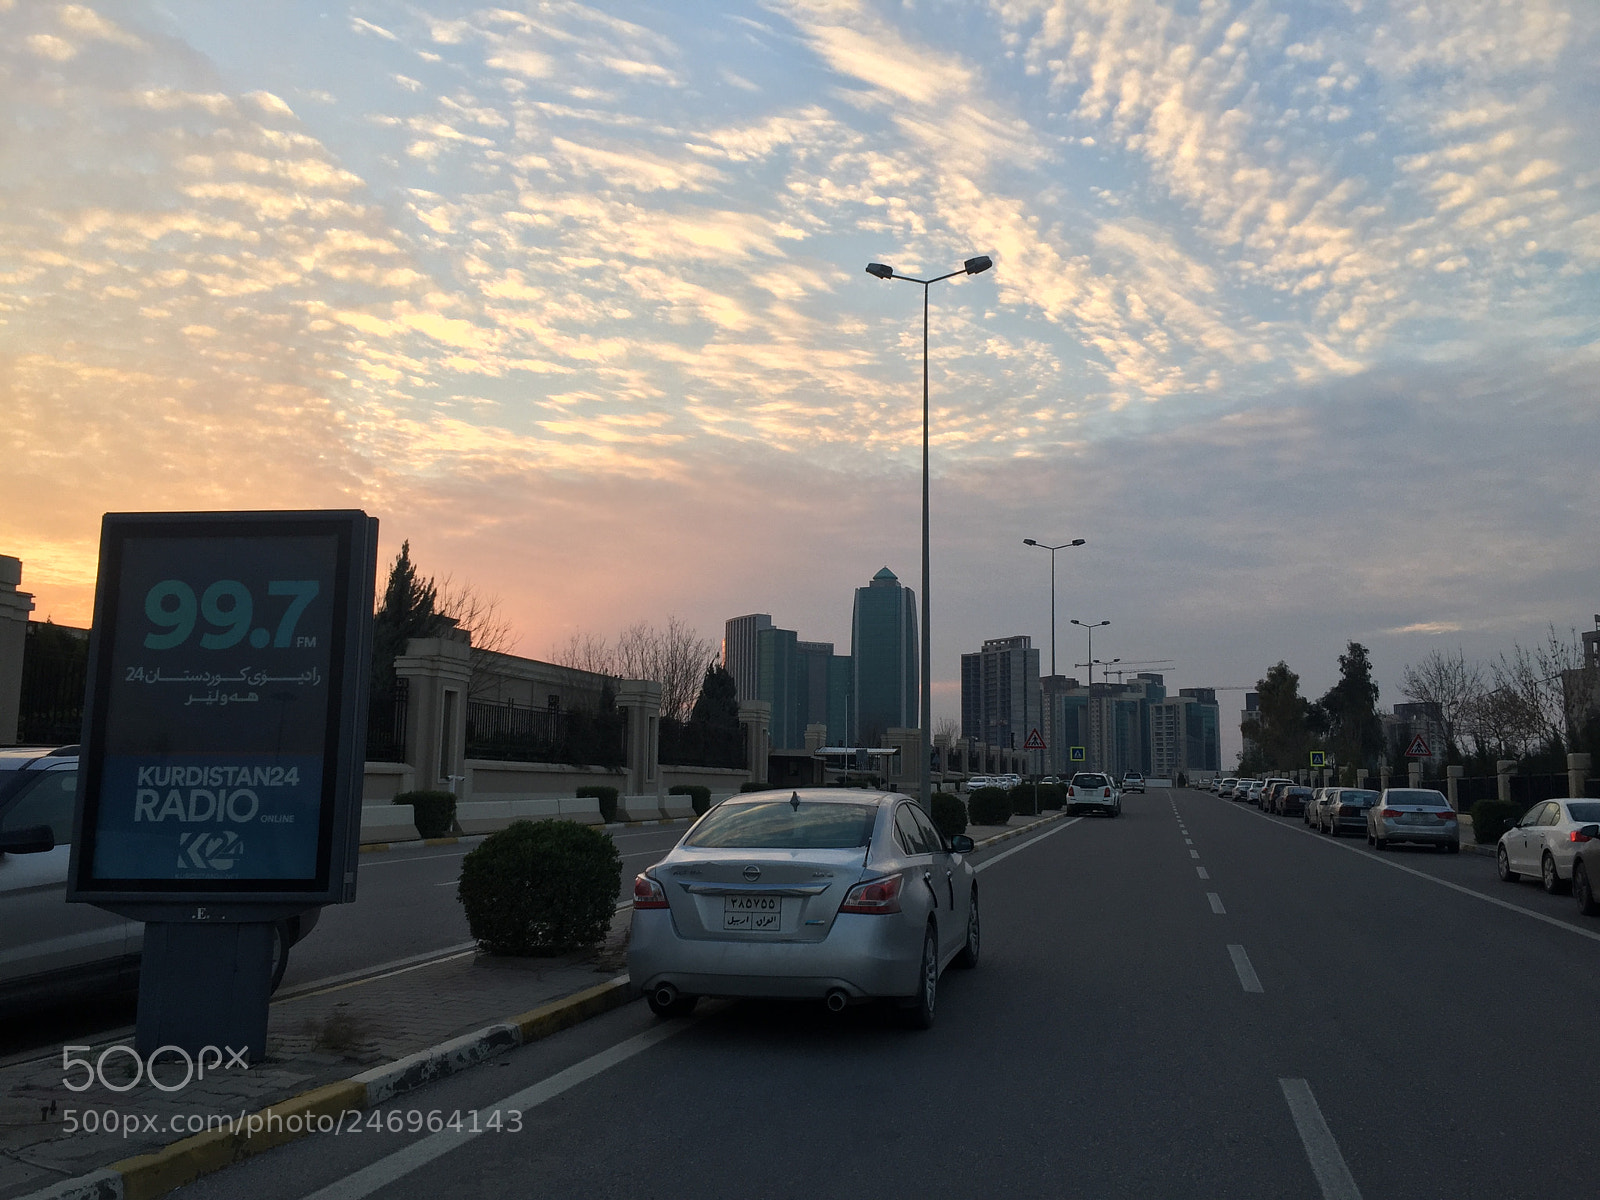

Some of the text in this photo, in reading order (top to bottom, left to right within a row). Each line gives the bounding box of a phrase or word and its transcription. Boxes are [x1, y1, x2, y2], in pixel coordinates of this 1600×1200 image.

[144, 579, 320, 650] 99.7 FM
[138, 766, 300, 787] KURDISTAN24
[134, 788, 295, 823] RADIO ONLINE
